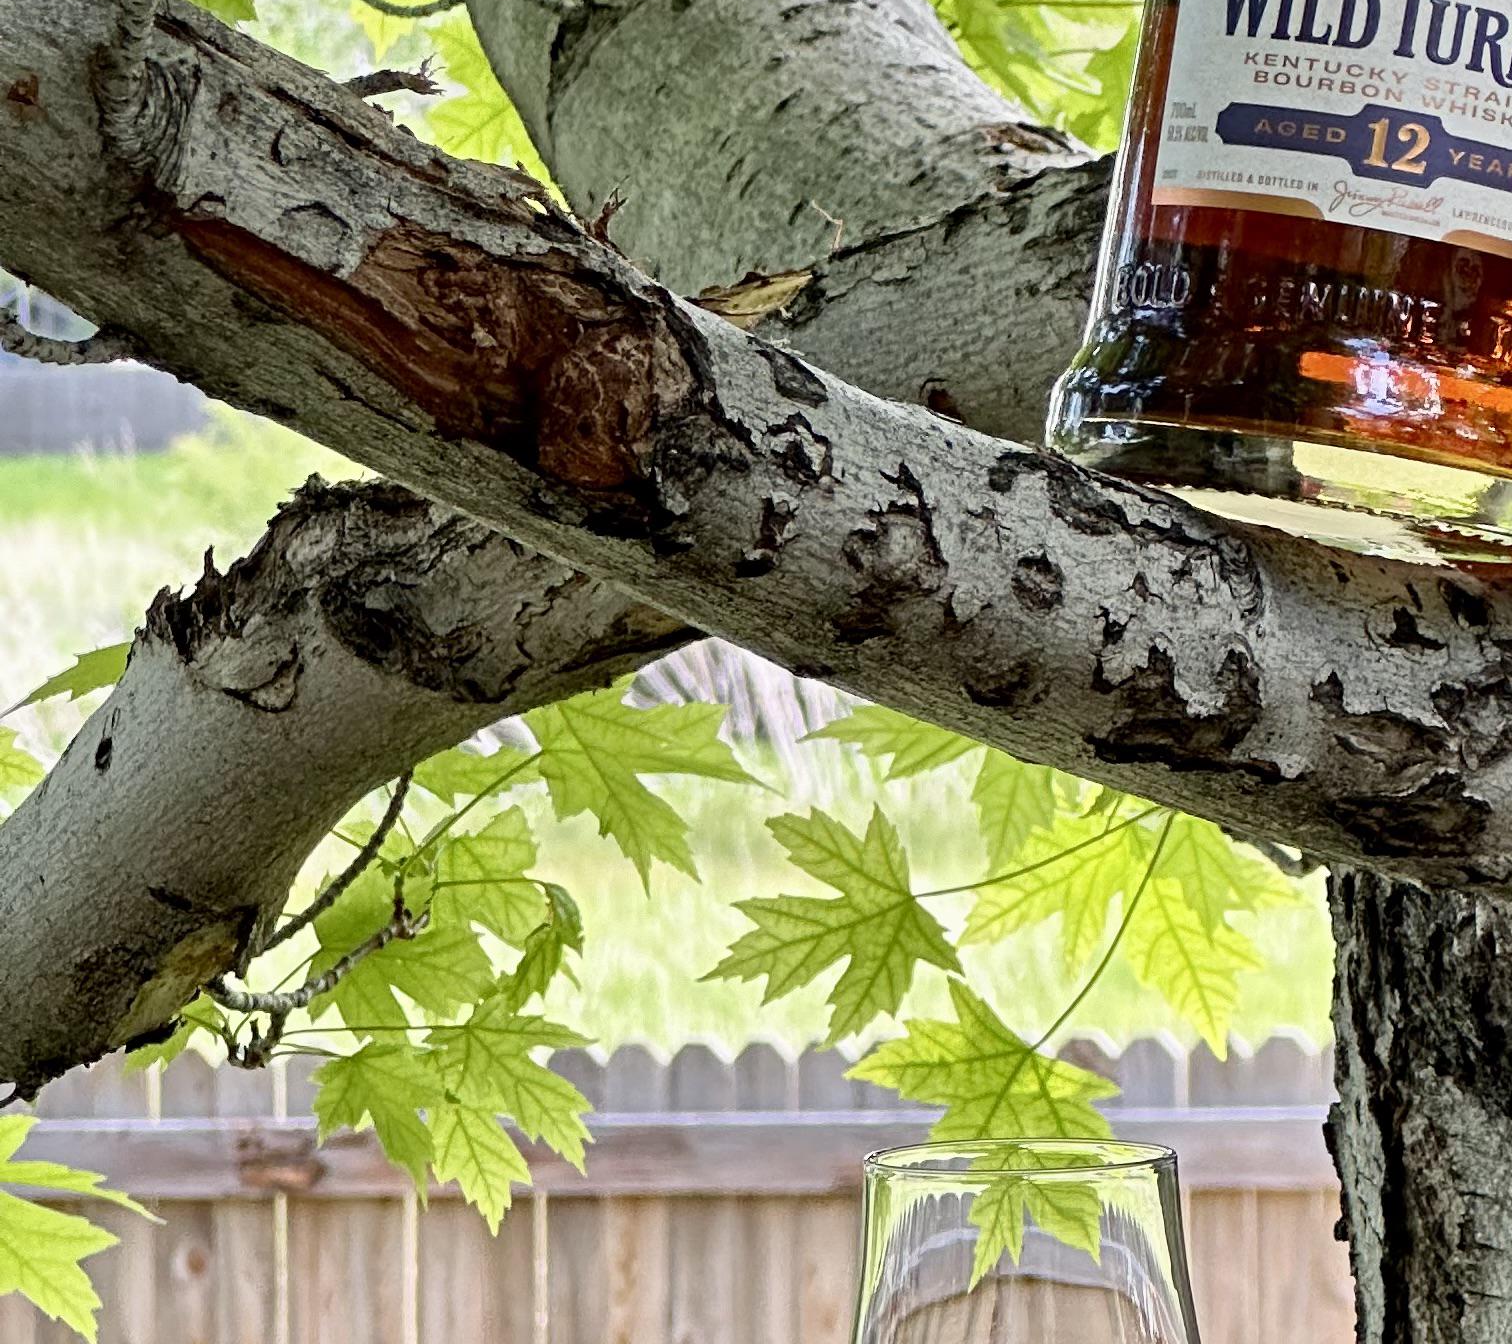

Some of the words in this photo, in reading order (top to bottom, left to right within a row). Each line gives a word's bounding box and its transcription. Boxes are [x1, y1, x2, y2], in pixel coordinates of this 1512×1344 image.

[1243, 51, 1406, 84] KENTUCKY
[1253, 69, 1405, 103] BOURBON
[1253, 118, 1347, 144] AGED
[1363, 117, 1431, 174] 12
[1258, 176, 1304, 190] BOTTLED
